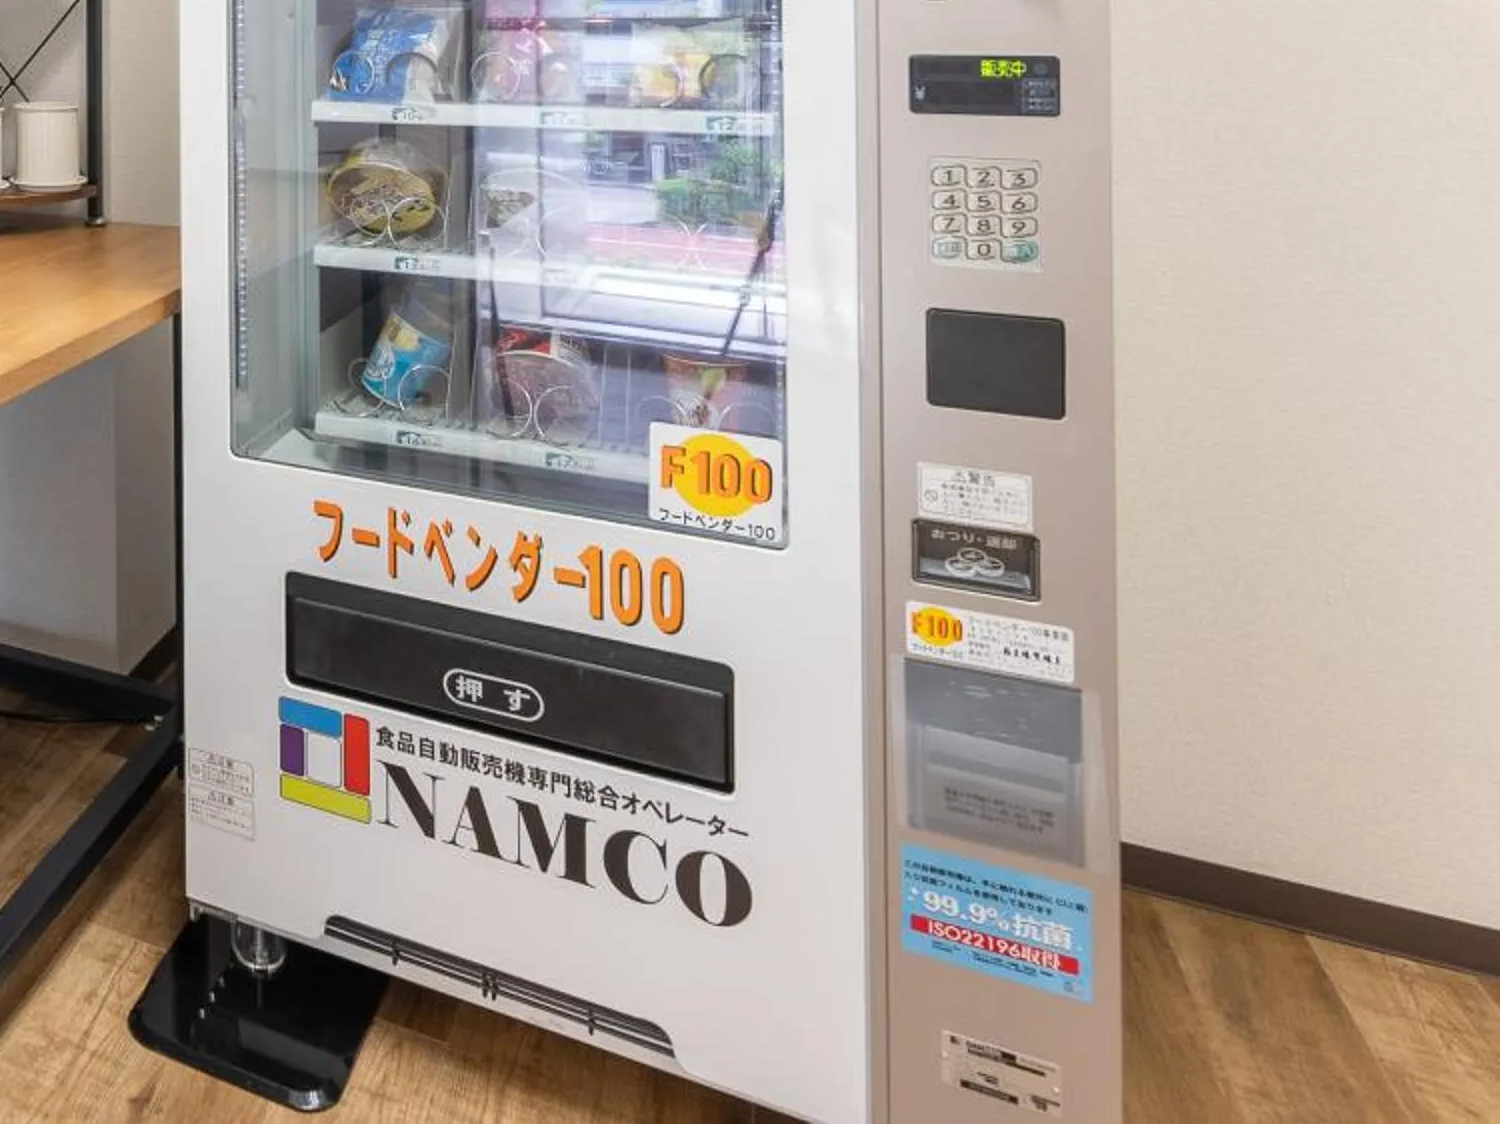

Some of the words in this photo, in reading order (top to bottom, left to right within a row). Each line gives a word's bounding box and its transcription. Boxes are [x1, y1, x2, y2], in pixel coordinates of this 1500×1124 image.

[943, 194, 955, 206] 4
[978, 196, 991, 208] 5
[1012, 198, 1026, 210] 6
[942, 217, 955, 229] 7
[977, 219, 991, 232] 8
[1012, 221, 1026, 234] 9
[978, 243, 991, 256] 0
[659, 507, 776, 541] フードベンダー100
[313, 498, 685, 636] フードベンダー100
[375, 725, 750, 839] 食品自動販売機専門総合オペレーター
[376, 759, 753, 927] NAMCO
[923, 890, 1076, 951] 99.9%抗菌
